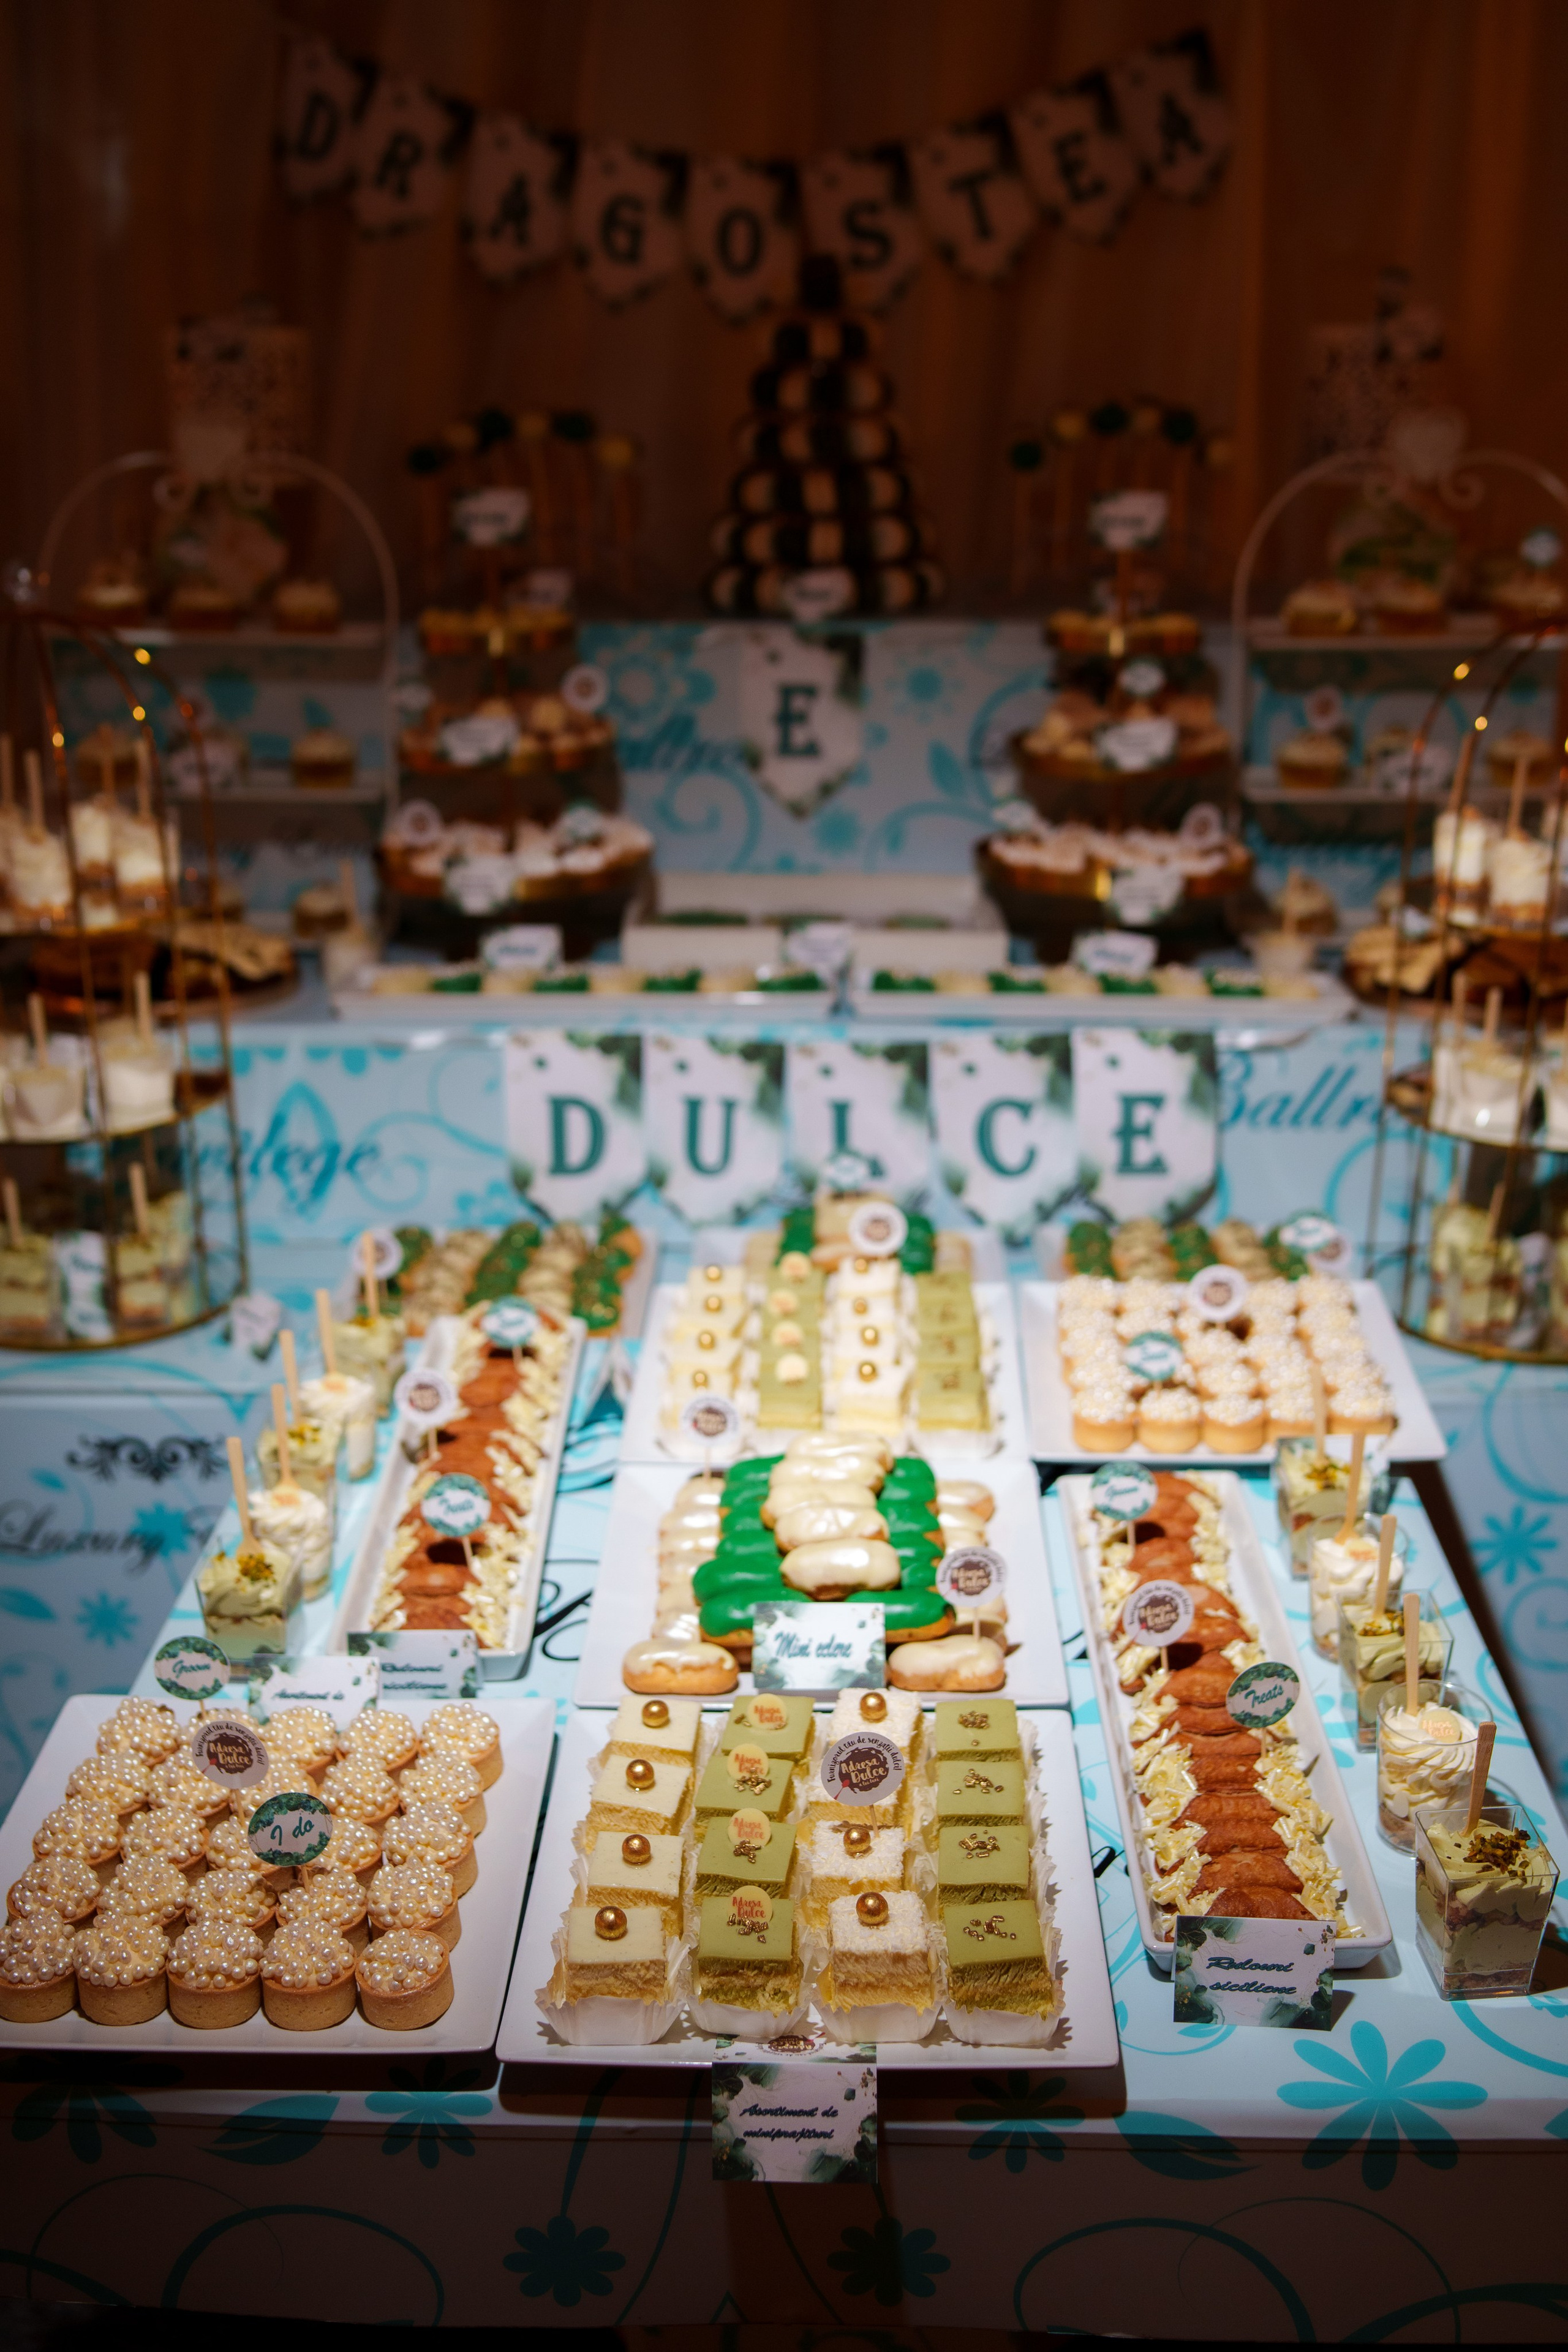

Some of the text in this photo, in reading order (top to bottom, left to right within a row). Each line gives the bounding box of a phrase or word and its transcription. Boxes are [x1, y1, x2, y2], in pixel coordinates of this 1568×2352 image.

[294, 87, 1208, 279] DRAGOSTEA
[775, 683, 820, 758] E
[1244, 1684, 1284, 1709] Treats
[209, 1742, 246, 1755] Adresa
[218, 1751, 251, 1765] Dulce
[827, 1746, 846, 1783] Furnizorul
[857, 1736, 867, 1744] de
[840, 1758, 880, 1774] Adresa
[850, 1767, 887, 1784] Dulce
[270, 1815, 315, 1846] I do
[732, 1896, 763, 1908] Adresa
[737, 1906, 766, 1918] Dulce
[1205, 1956, 1295, 1972] Rulouri
[821, 2105, 839, 2117] de
